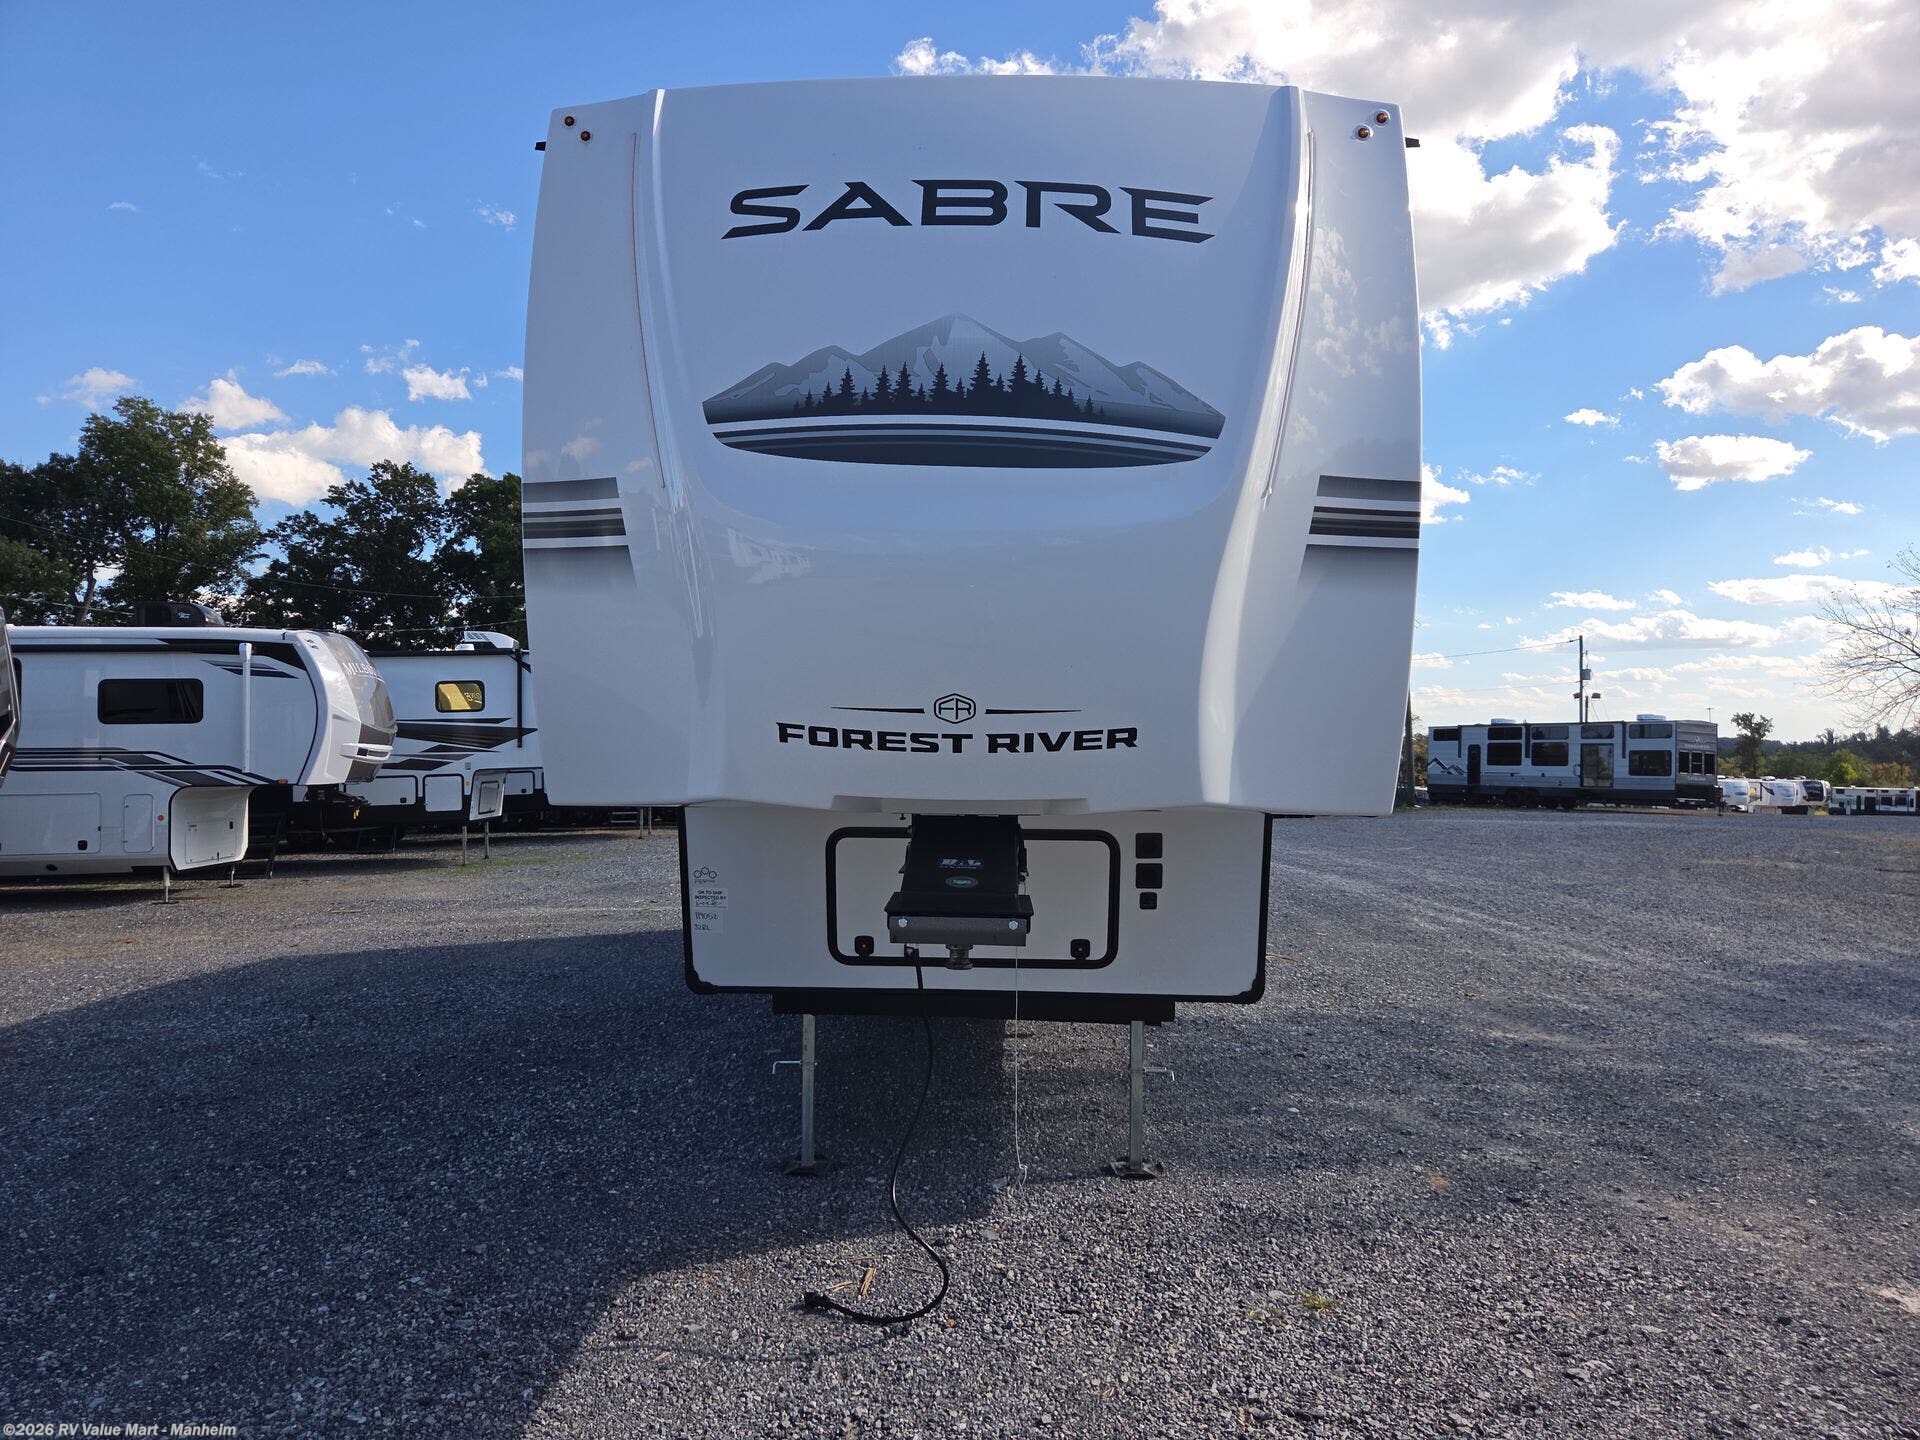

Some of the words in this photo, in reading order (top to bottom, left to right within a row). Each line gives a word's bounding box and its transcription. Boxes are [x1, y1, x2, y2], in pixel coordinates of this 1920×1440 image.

[721, 179, 1215, 243] SABRE
[936, 696, 974, 721] FR
[776, 722, 973, 753] FOREST
[985, 727, 1138, 753] RIVER
